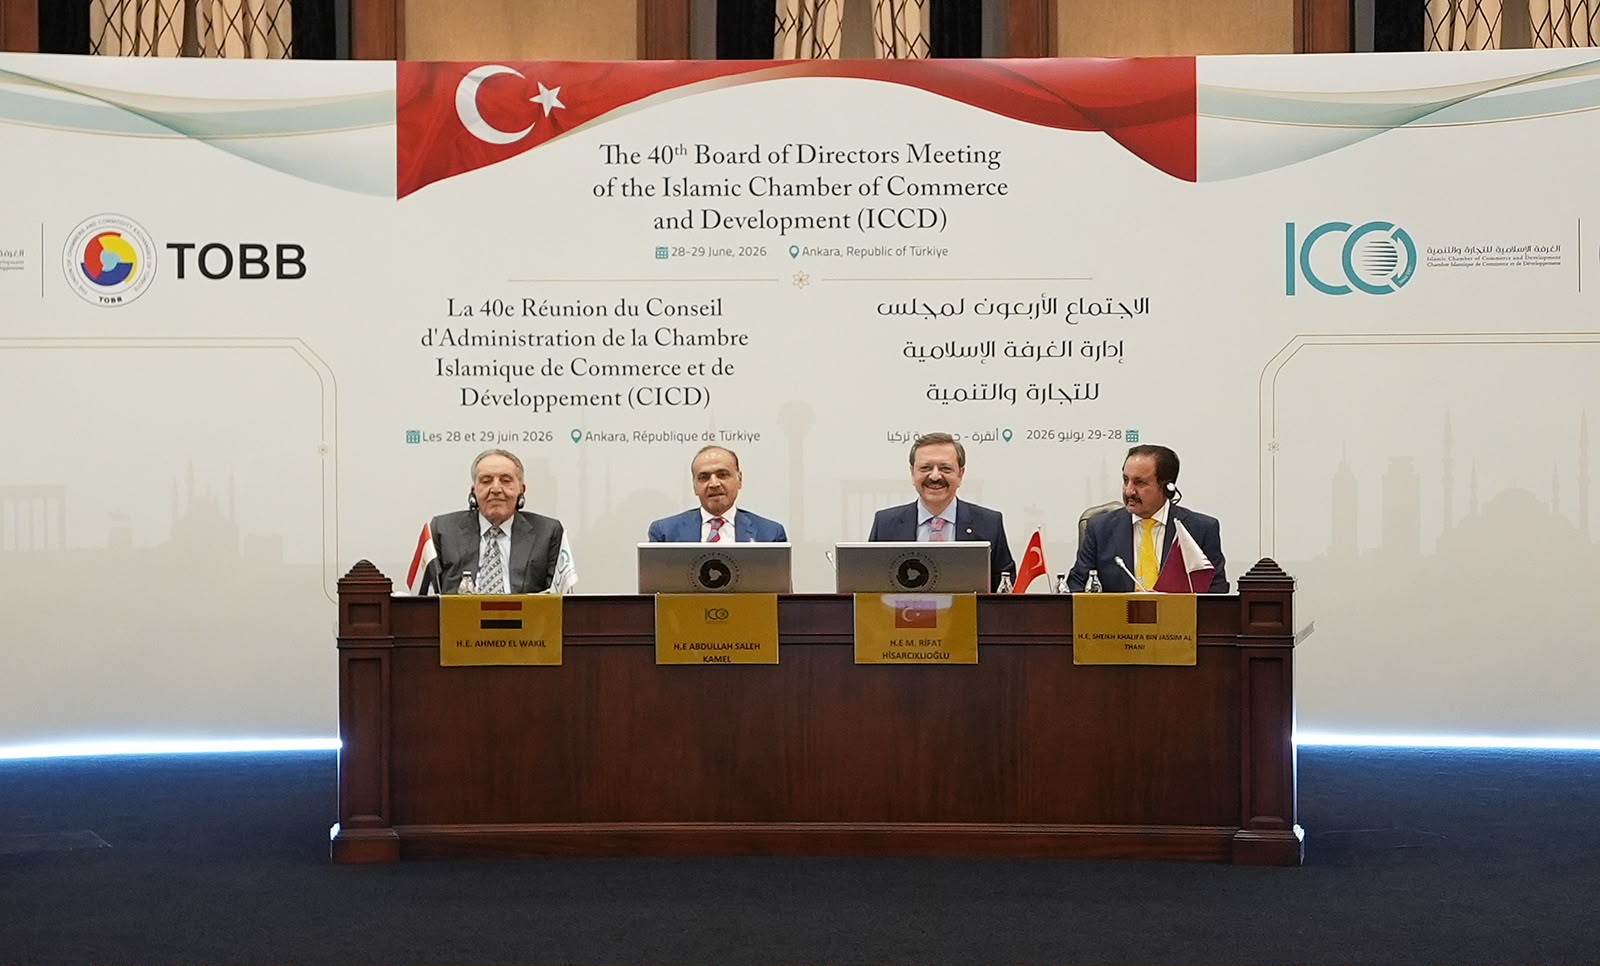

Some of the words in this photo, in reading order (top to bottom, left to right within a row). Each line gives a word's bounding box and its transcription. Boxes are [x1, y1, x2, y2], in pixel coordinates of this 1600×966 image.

[599, 143, 641, 165] The
[647, 143, 688, 165] 40th
[695, 143, 761, 165] Board
[767, 143, 793, 165] of
[796, 143, 900, 164] Directors
[906, 143, 1002, 171] Meeting
[592, 176, 618, 198] of
[621, 177, 655, 198] the
[663, 176, 742, 197] Islamic
[748, 176, 853, 197] Chamber
[858, 175, 884, 197] of
[887, 175, 1008, 197] Commerce
[653, 209, 694, 230] and
[702, 209, 851, 236] Development
[857, 208, 947, 233] (ICCD)
[166, 242, 307, 280] TOBB
[671, 246, 706, 257] 28-29
[707, 246, 736, 258] June,
[738, 246, 768, 257] 2026
[801, 246, 844, 258] Ankara,
[846, 245, 893, 259] Republic
[895, 245, 907, 257] of
[909, 245, 949, 259] Türkiye
[98, 295, 123, 304] TOBB
[448, 298, 474, 317] La
[479, 299, 515, 317] 40e
[522, 298, 608, 317] Réunion
[614, 298, 639, 317] du
[646, 298, 722, 317] Conseil
[877, 298, 965, 320] لمجلس
[974, 293, 1057, 320] الأربعون
[1065, 297, 1149, 325] الاجتماع
[421, 327, 596, 347] d'Administration
[602, 327, 625, 347] de
[631, 327, 648, 347] la
[654, 327, 749, 347] Chambre
[903, 340, 996, 364] الإسلامية
[1003, 340, 1072, 362] الغرفة
[1080, 340, 1123, 364] إدارة
[437, 358, 535, 383] Islamique
[540, 357, 564, 377] de
[570, 357, 681, 377] Commerce
[687, 362, 705, 376] et
[711, 357, 734, 376] de
[461, 387, 622, 413] Développement
[628, 387, 710, 409] (CICD)
[926, 383, 1017, 406] والتنمية
[1026, 382, 1099, 405] للتجارة
[422, 431, 443, 443] Les
[446, 430, 462, 442] 28
[464, 432, 476, 442] et
[479, 430, 495, 442] 29
[496, 431, 519, 445] juin
[522, 430, 554, 442] 2026
[584, 431, 630, 443] Ankara,
[632, 430, 699, 445] République
[701, 431, 716, 443] de
[718, 430, 761, 444] Türkiye
[887, 431, 911, 445] تركيا
[971, 427, 999, 445] أنقرة
[1026, 429, 1056, 440] 2026
[1057, 429, 1085, 443] يونيو
[456, 639, 473, 648] H.E.
[474, 639, 507, 648] AHMED
[508, 639, 518, 648] EL
[518, 639, 547, 648] WAKIL
[673, 642, 687, 651] H.E
[688, 642, 734, 651] ABDULLAH
[734, 642, 761, 651] SALEH
[702, 655, 732, 663] KAMEL
